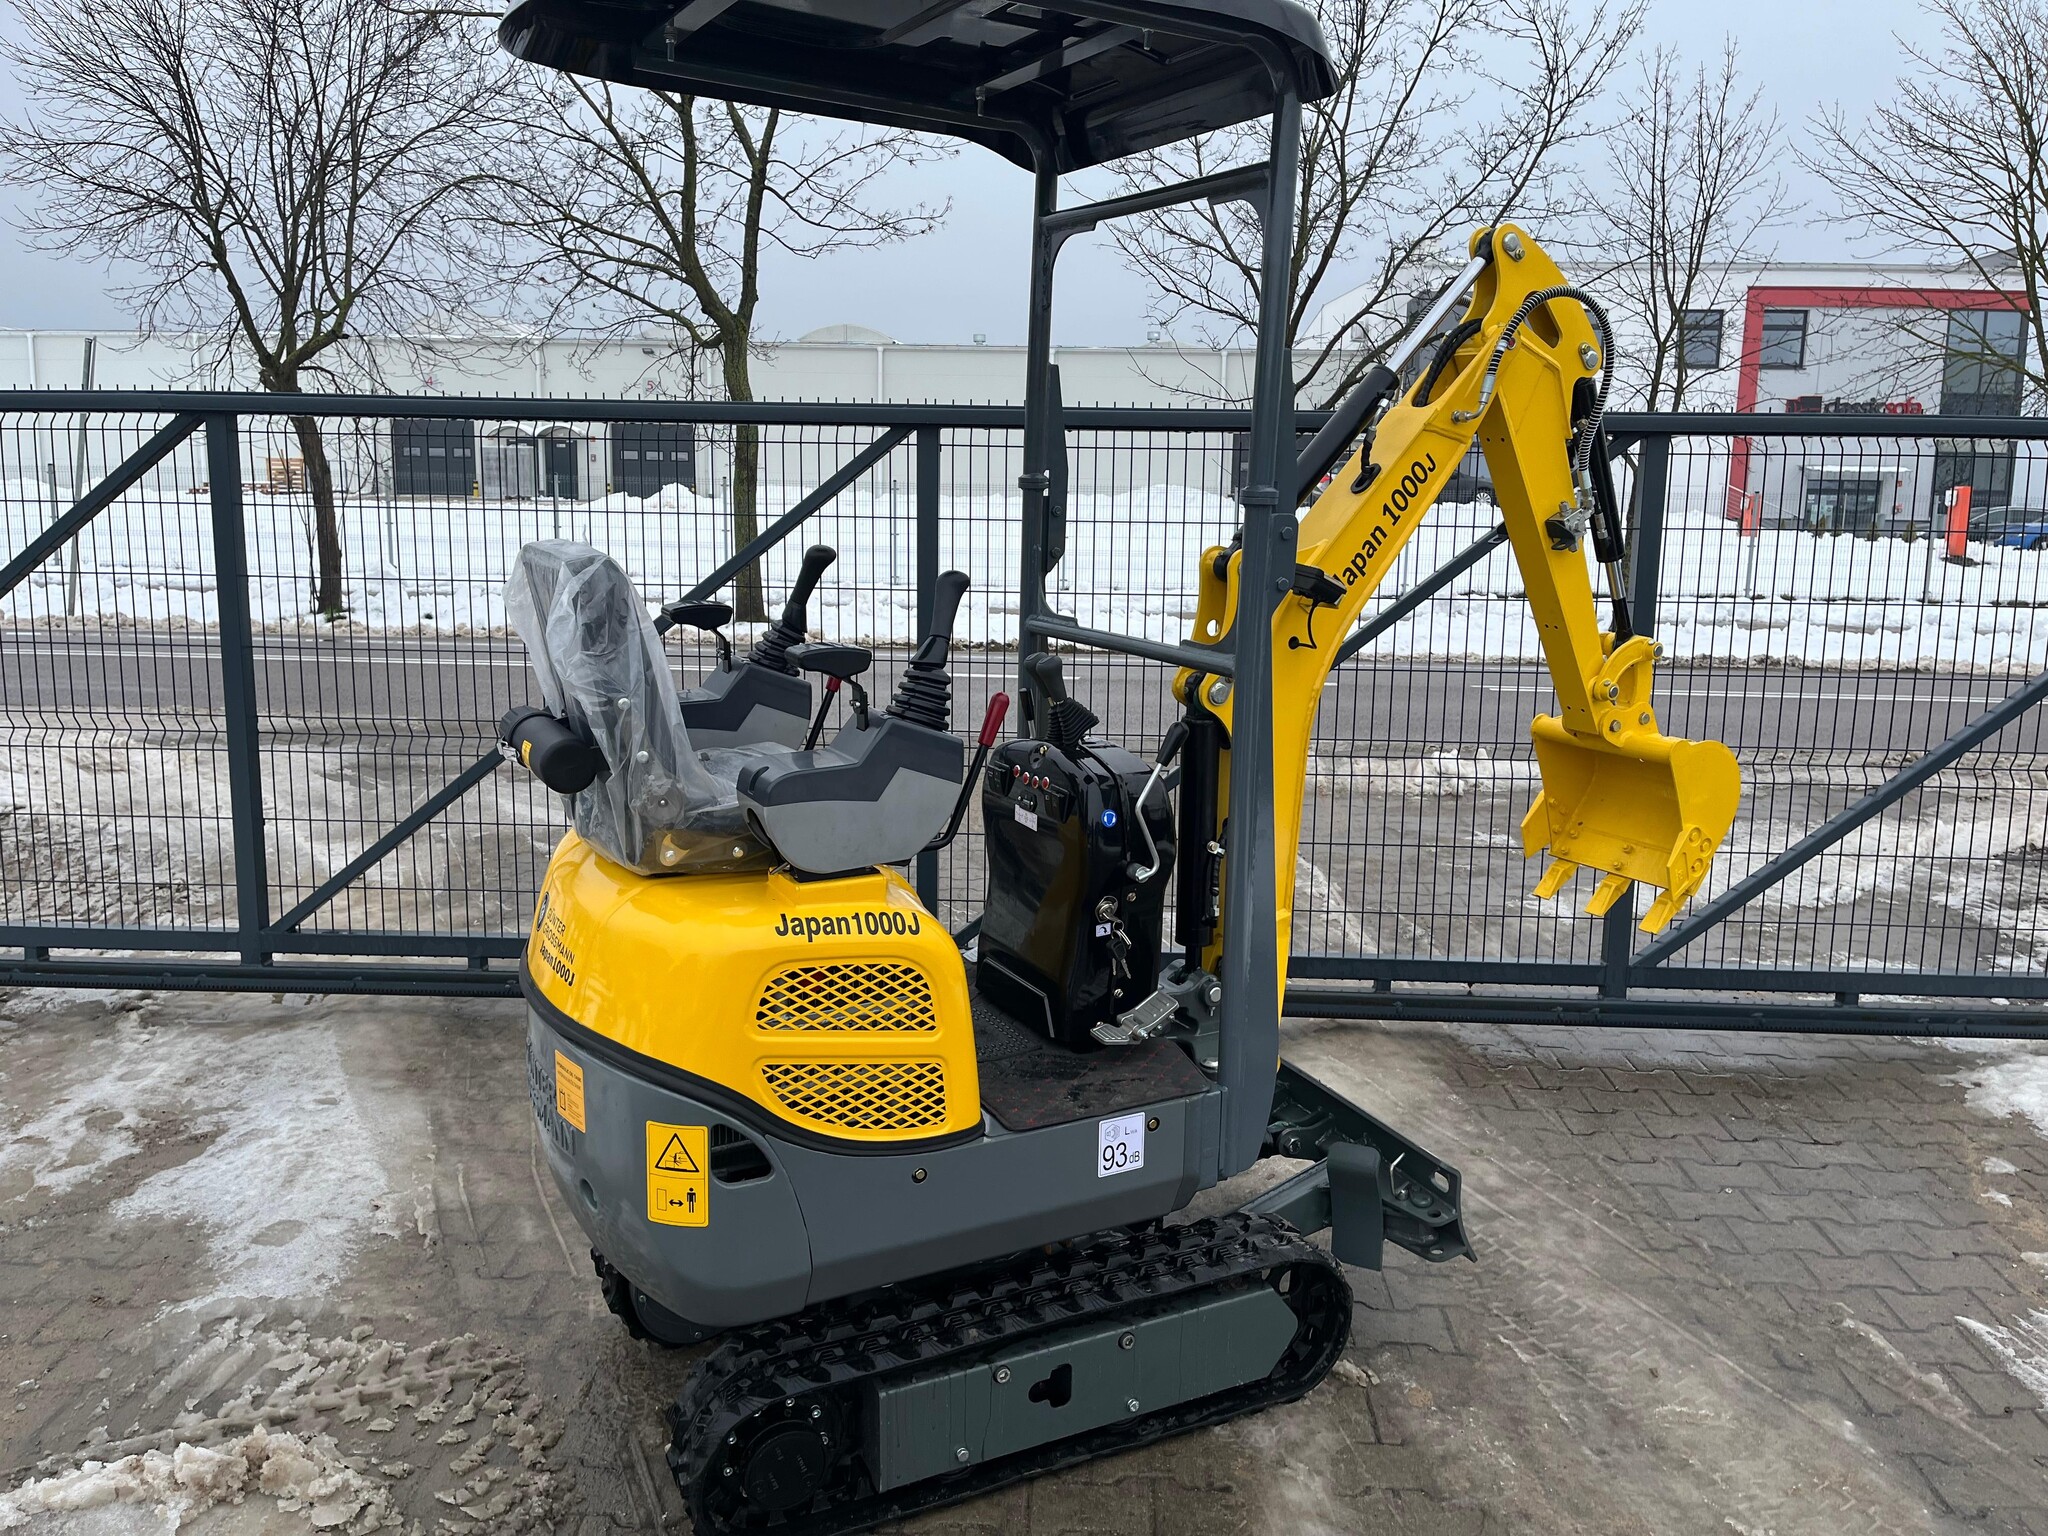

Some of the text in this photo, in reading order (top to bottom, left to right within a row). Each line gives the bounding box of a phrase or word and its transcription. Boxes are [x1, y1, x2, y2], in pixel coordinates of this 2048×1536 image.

[646, 380, 654, 391] 5
[1382, 452, 1436, 527] 1000J
[775, 911, 920, 943] Japan1000J
[1103, 1142, 1141, 1171] 93 dB
